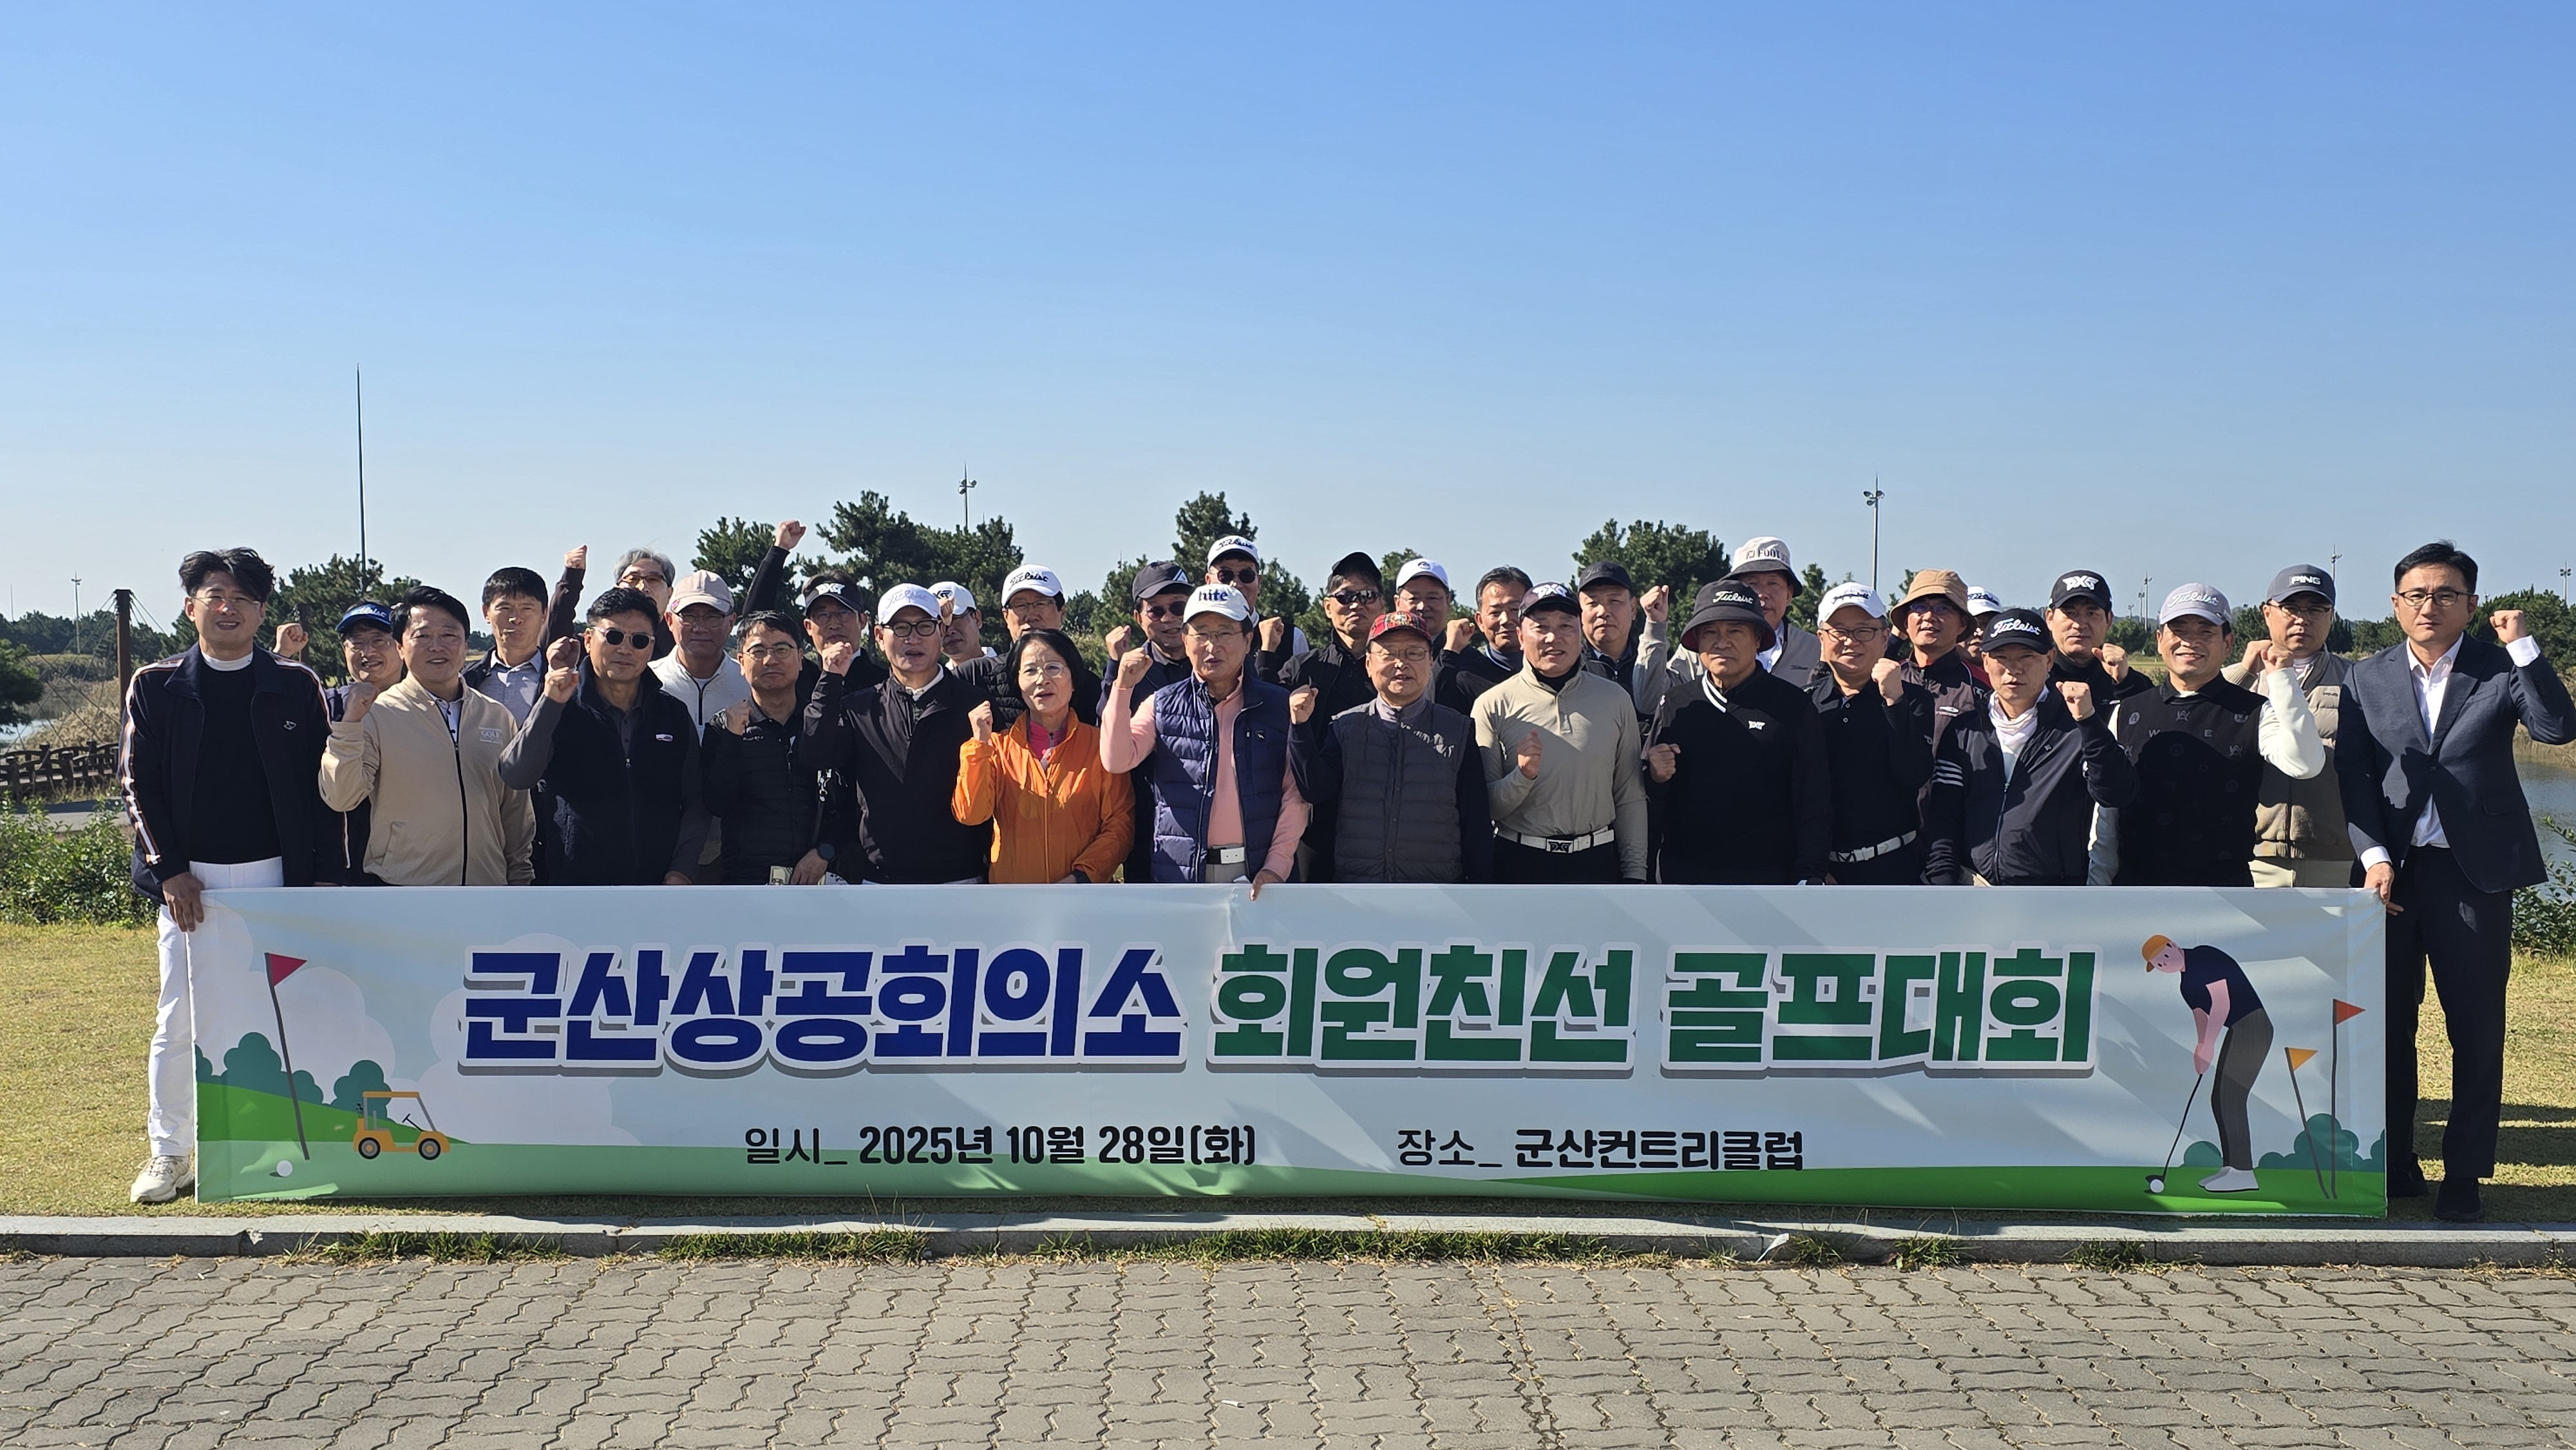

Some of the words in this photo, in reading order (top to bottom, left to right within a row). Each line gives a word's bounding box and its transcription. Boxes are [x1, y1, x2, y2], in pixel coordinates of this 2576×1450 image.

[2291, 576, 2321, 585] PING
[1713, 590, 1754, 604] Titleist
[2168, 590, 2220, 608] Titleist
[1991, 617, 2041, 638] Titleist
[466, 945, 1181, 1062] 군산상공회의소
[1215, 945, 1633, 1062] 회원친선
[1669, 949, 2095, 1063] 골프대회
[745, 1127, 848, 1165] 일시_
[859, 1125, 993, 1165] 2025년
[1006, 1125, 1085, 1164] 10월
[1099, 1125, 1255, 1165] 28일(화)
[1397, 1129, 1503, 1167] 장소_
[1515, 1129, 1803, 1171] 군산컨트리클럽
